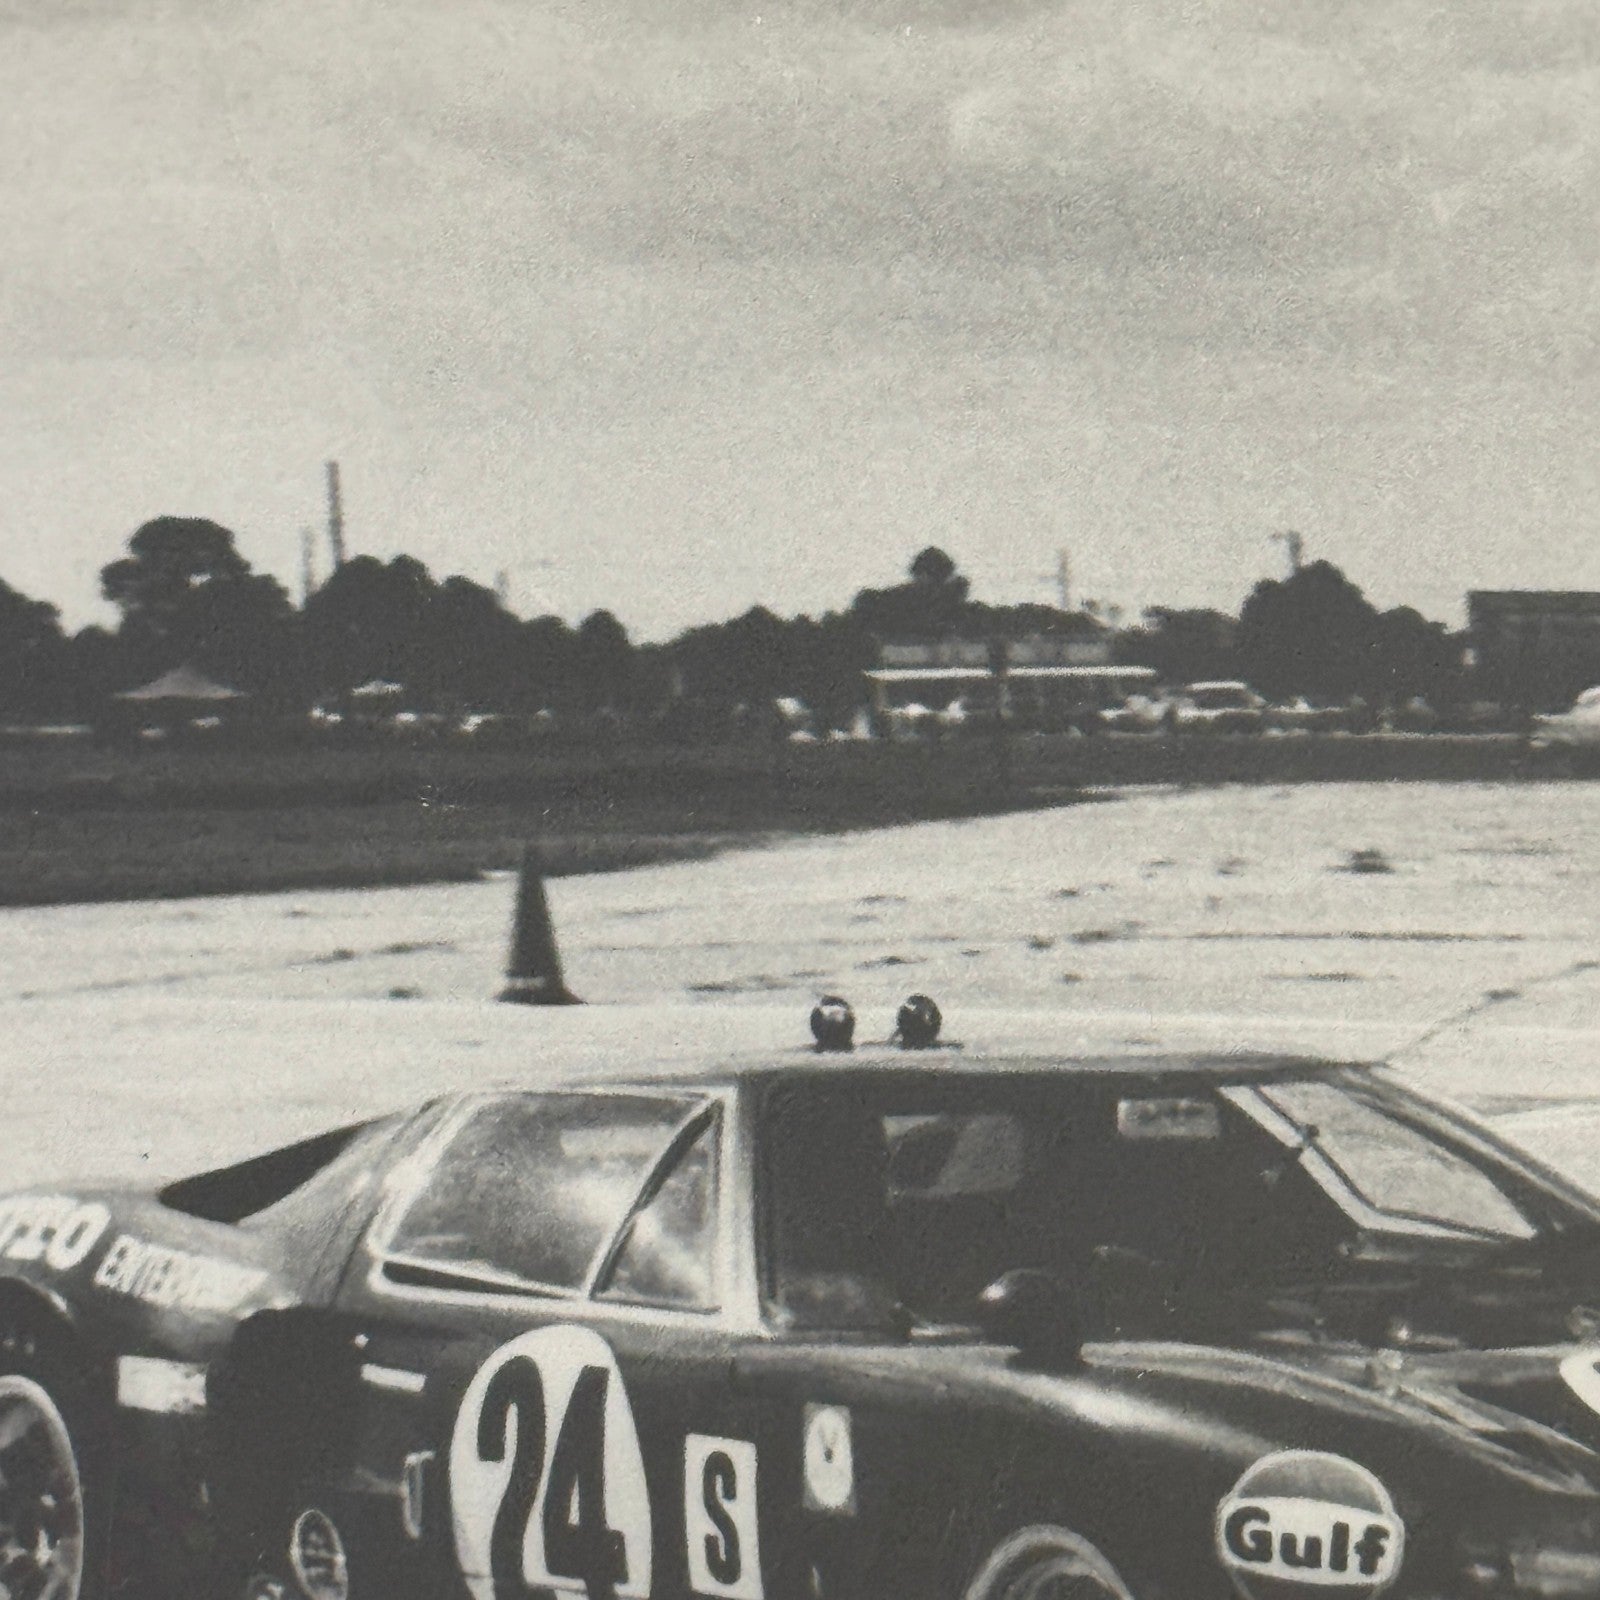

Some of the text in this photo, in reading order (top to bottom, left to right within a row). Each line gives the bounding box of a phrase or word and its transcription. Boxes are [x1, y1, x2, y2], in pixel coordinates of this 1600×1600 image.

[476, 1355, 628, 1600] 24
[702, 1450, 742, 1585] S
[1225, 1506, 1390, 1575] Gulf
